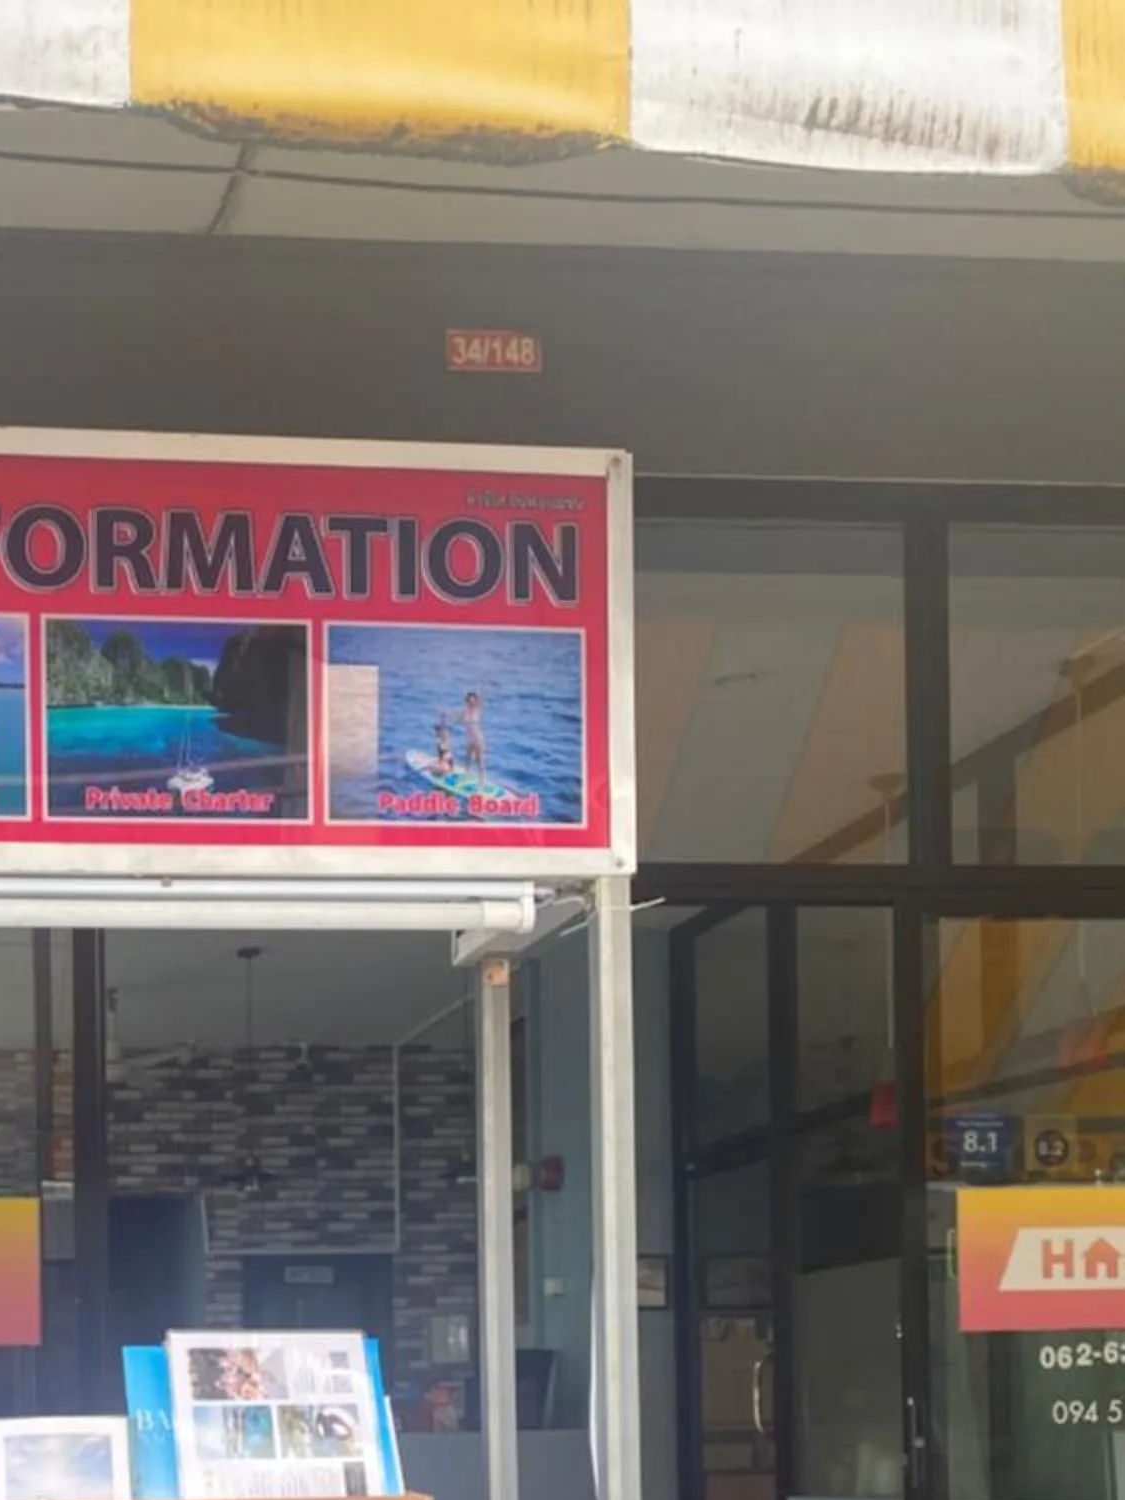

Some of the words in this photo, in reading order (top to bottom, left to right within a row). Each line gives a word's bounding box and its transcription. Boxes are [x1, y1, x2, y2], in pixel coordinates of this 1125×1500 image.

[451, 335, 536, 365] 34/148
[85, 786, 173, 811] Private
[181, 786, 274, 812] Charter
[377, 791, 458, 815] Paddle
[467, 792, 539, 817] Board
[963, 1130, 998, 1153] 8.1
[1052, 1400, 1099, 1424] 094
[1107, 1400, 1123, 1424] 5
